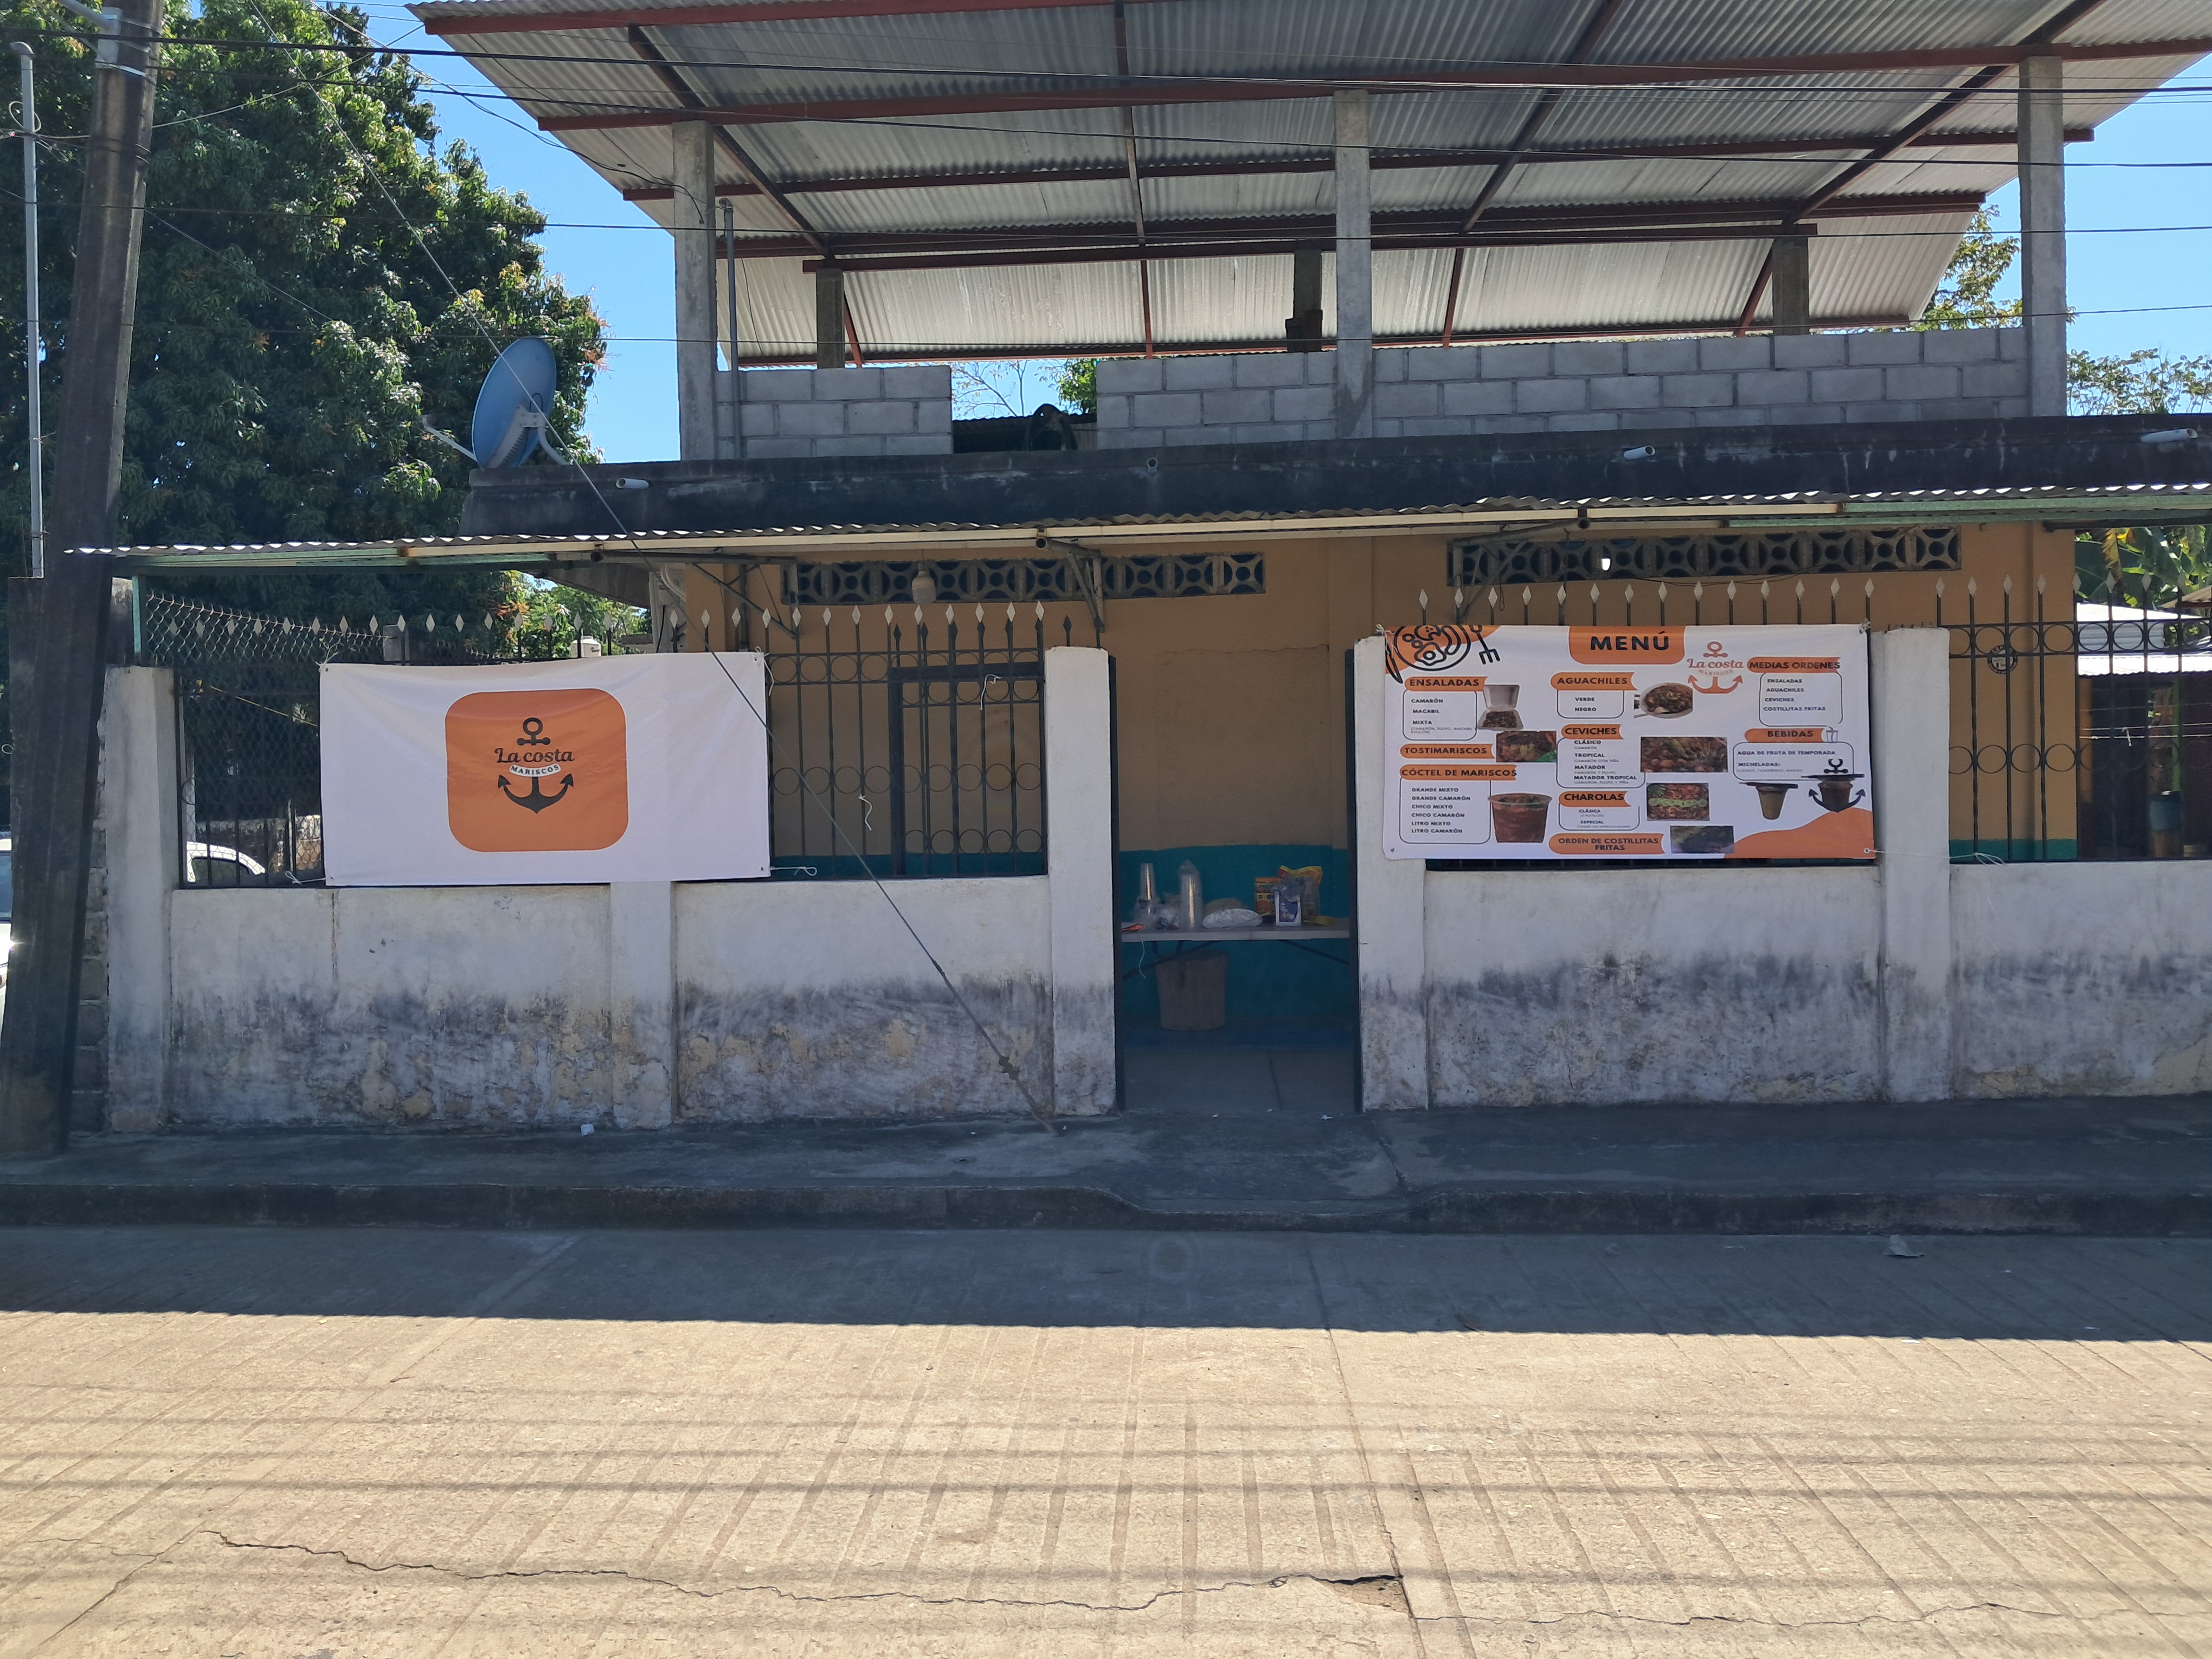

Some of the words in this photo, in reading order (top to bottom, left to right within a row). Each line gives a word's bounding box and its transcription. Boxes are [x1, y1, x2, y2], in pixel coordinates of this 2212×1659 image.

[1590, 631, 1669, 651] MENÚ
[1687, 658, 1706, 668] La
[1708, 660, 1745, 668] costa
[494, 748, 521, 763] La
[523, 749, 575, 763] costa
[511, 765, 560, 775] MARISCOS
[1401, 768, 1441, 776] CÓCTEL
